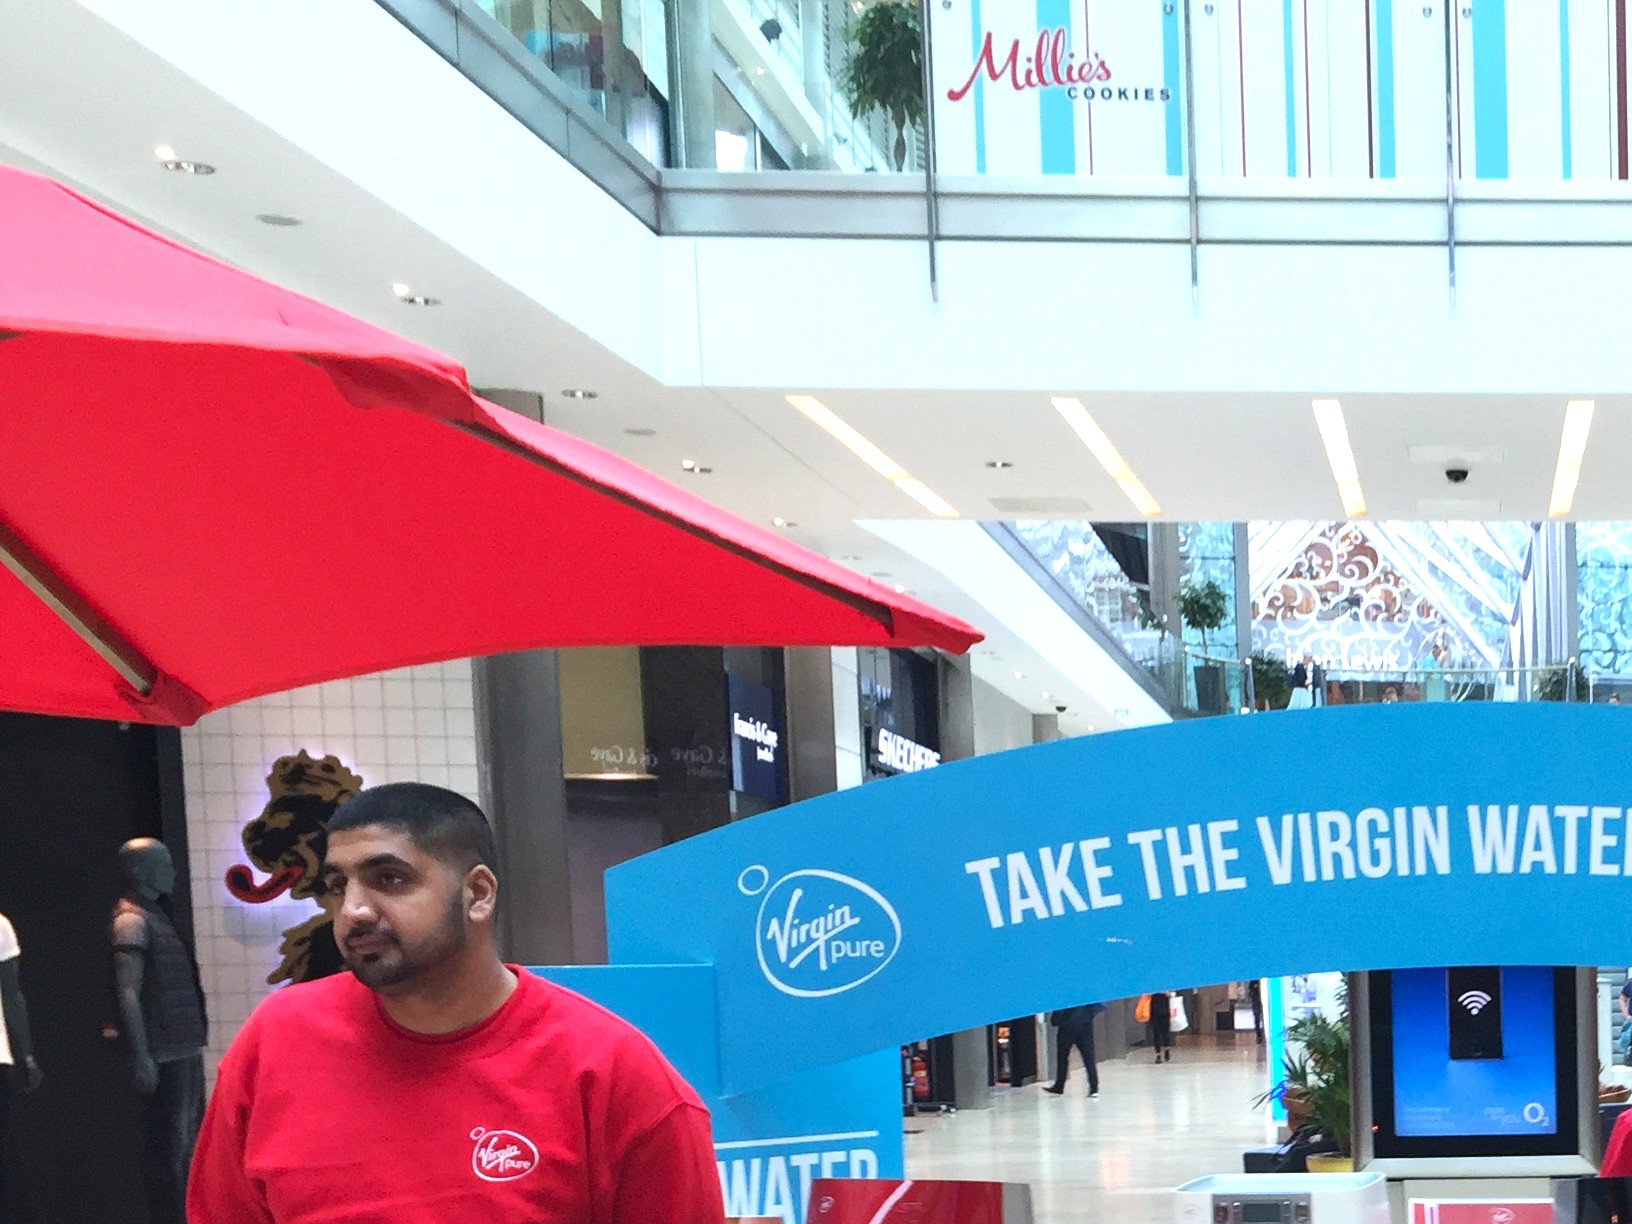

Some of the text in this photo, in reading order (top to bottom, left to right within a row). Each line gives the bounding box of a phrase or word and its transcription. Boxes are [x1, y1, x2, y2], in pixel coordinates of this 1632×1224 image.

[947, 28, 1111, 101] Millie's
[1068, 86, 1171, 101] COOKIES
[965, 837, 1123, 929] TAKE
[1127, 819, 1247, 900] THE
[1256, 805, 1451, 885] VIRGIN
[766, 888, 861, 971] Virgin
[831, 939, 885, 964] pure
[1522, 1102, 1550, 1127] O2
